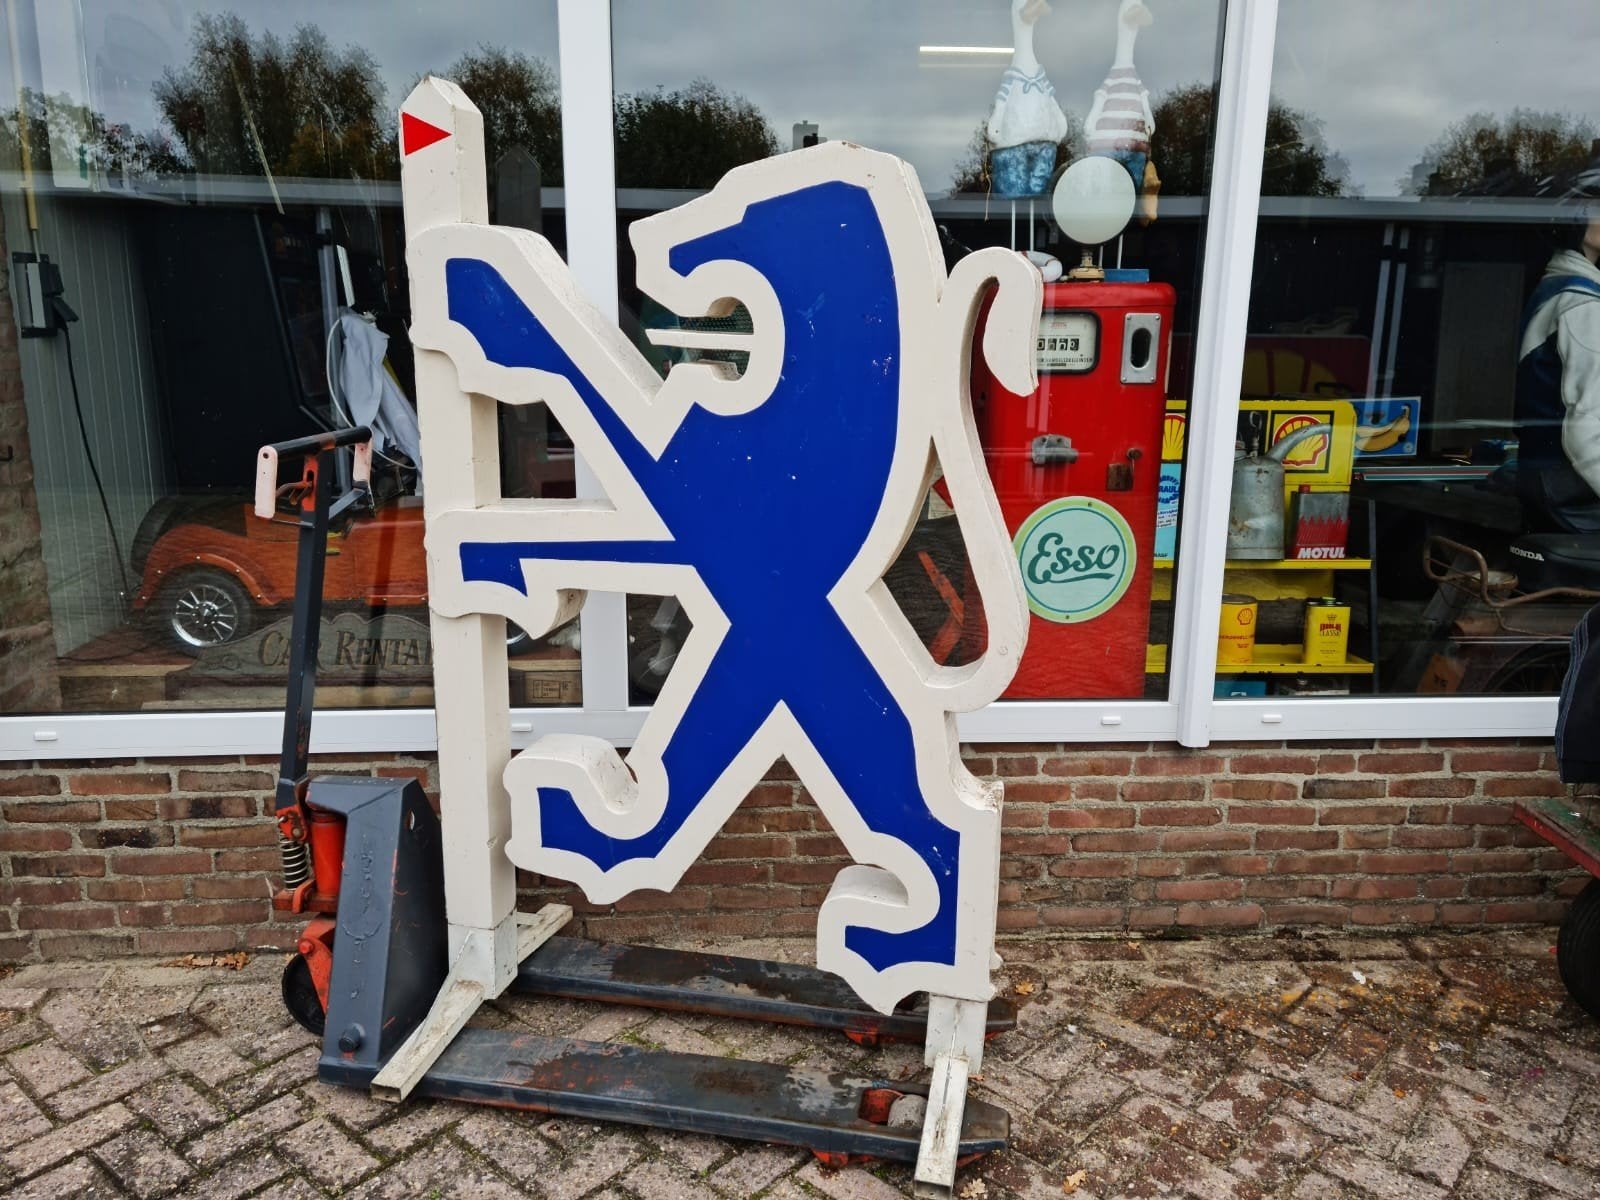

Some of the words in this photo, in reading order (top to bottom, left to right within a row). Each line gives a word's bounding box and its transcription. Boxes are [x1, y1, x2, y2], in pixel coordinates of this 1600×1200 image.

[1027, 532, 1120, 584] Esso
[1297, 546, 1345, 559] MOTUL
[1509, 546, 1545, 562] HONDA
